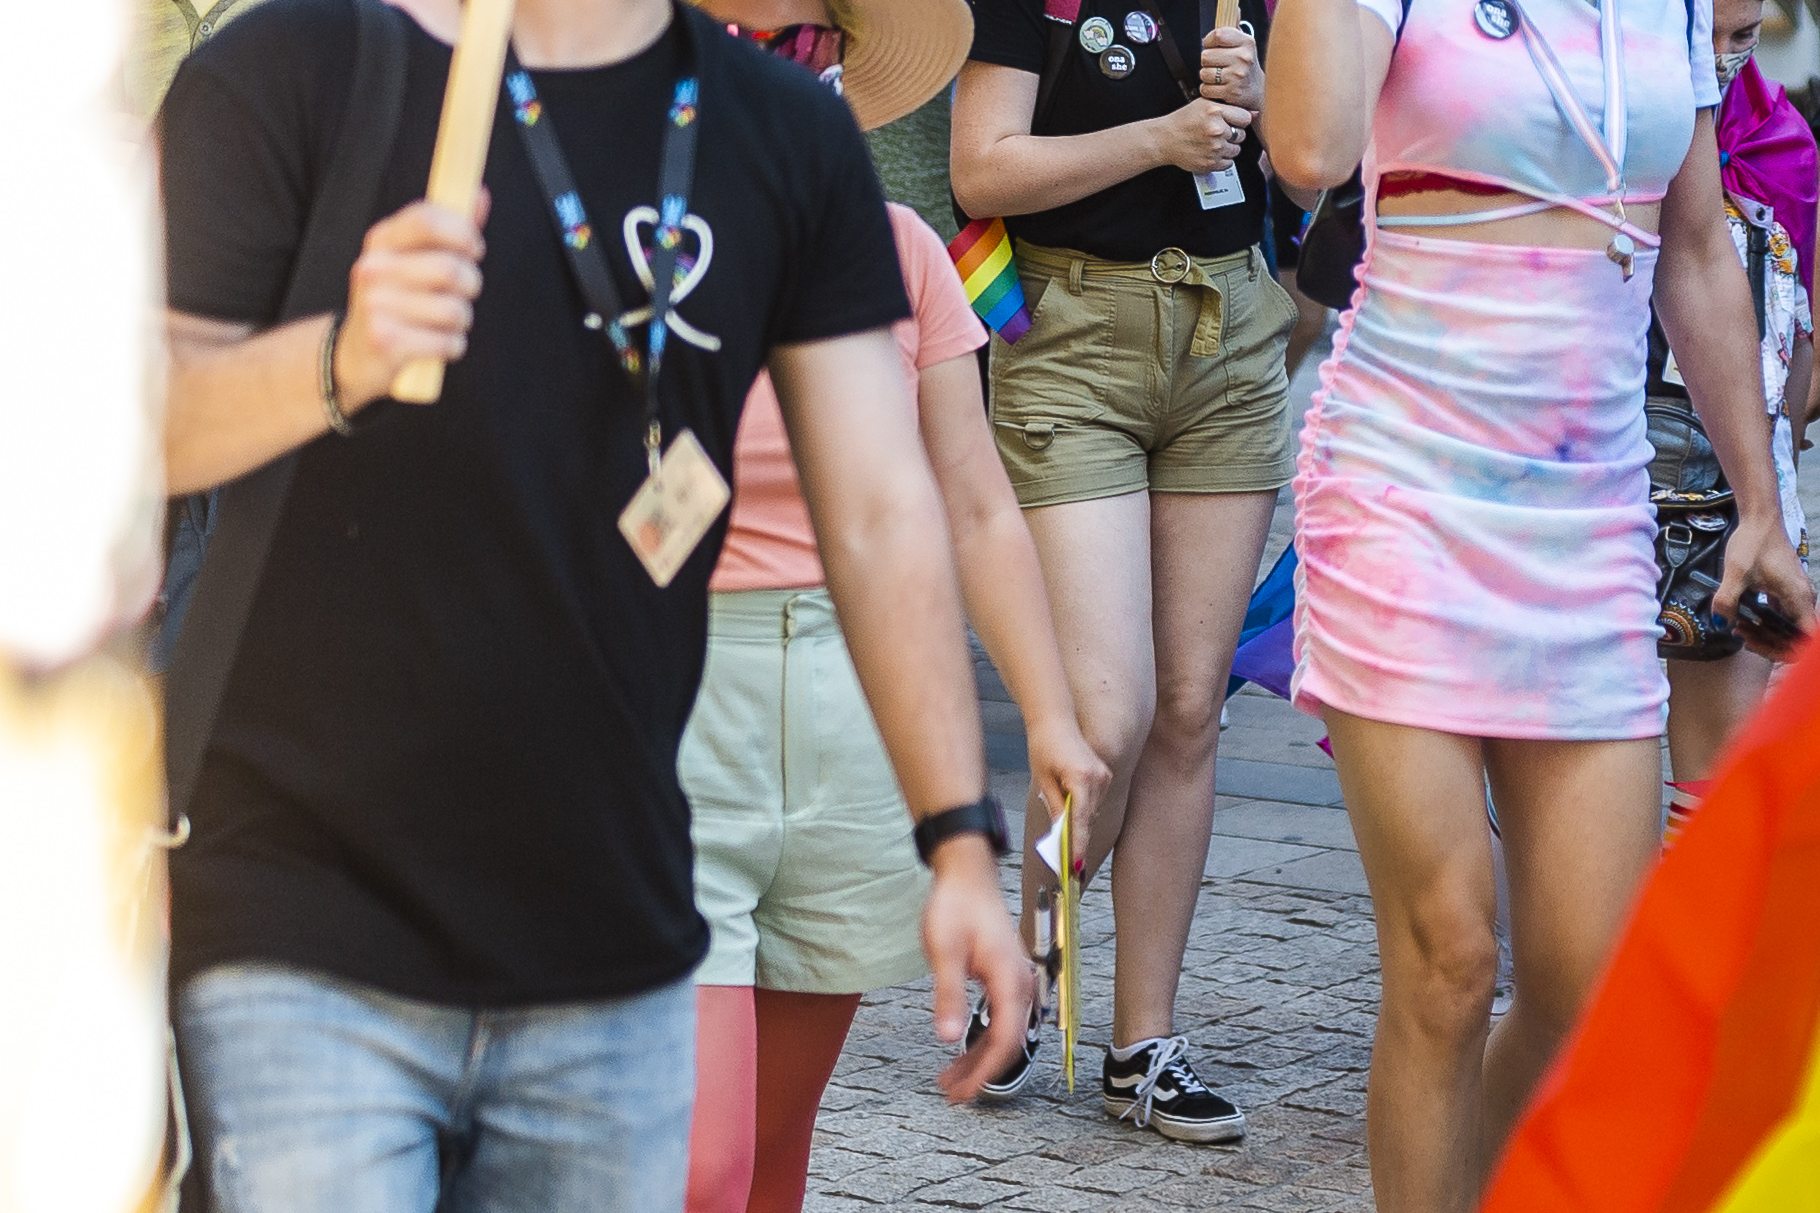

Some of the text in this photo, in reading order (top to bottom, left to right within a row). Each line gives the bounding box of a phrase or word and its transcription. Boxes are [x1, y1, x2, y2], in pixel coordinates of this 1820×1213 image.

[1486, 3, 1507, 19] ona
[1491, 14, 1510, 29] she
[1108, 55, 1126, 64] ona
[1111, 62, 1128, 71] she
